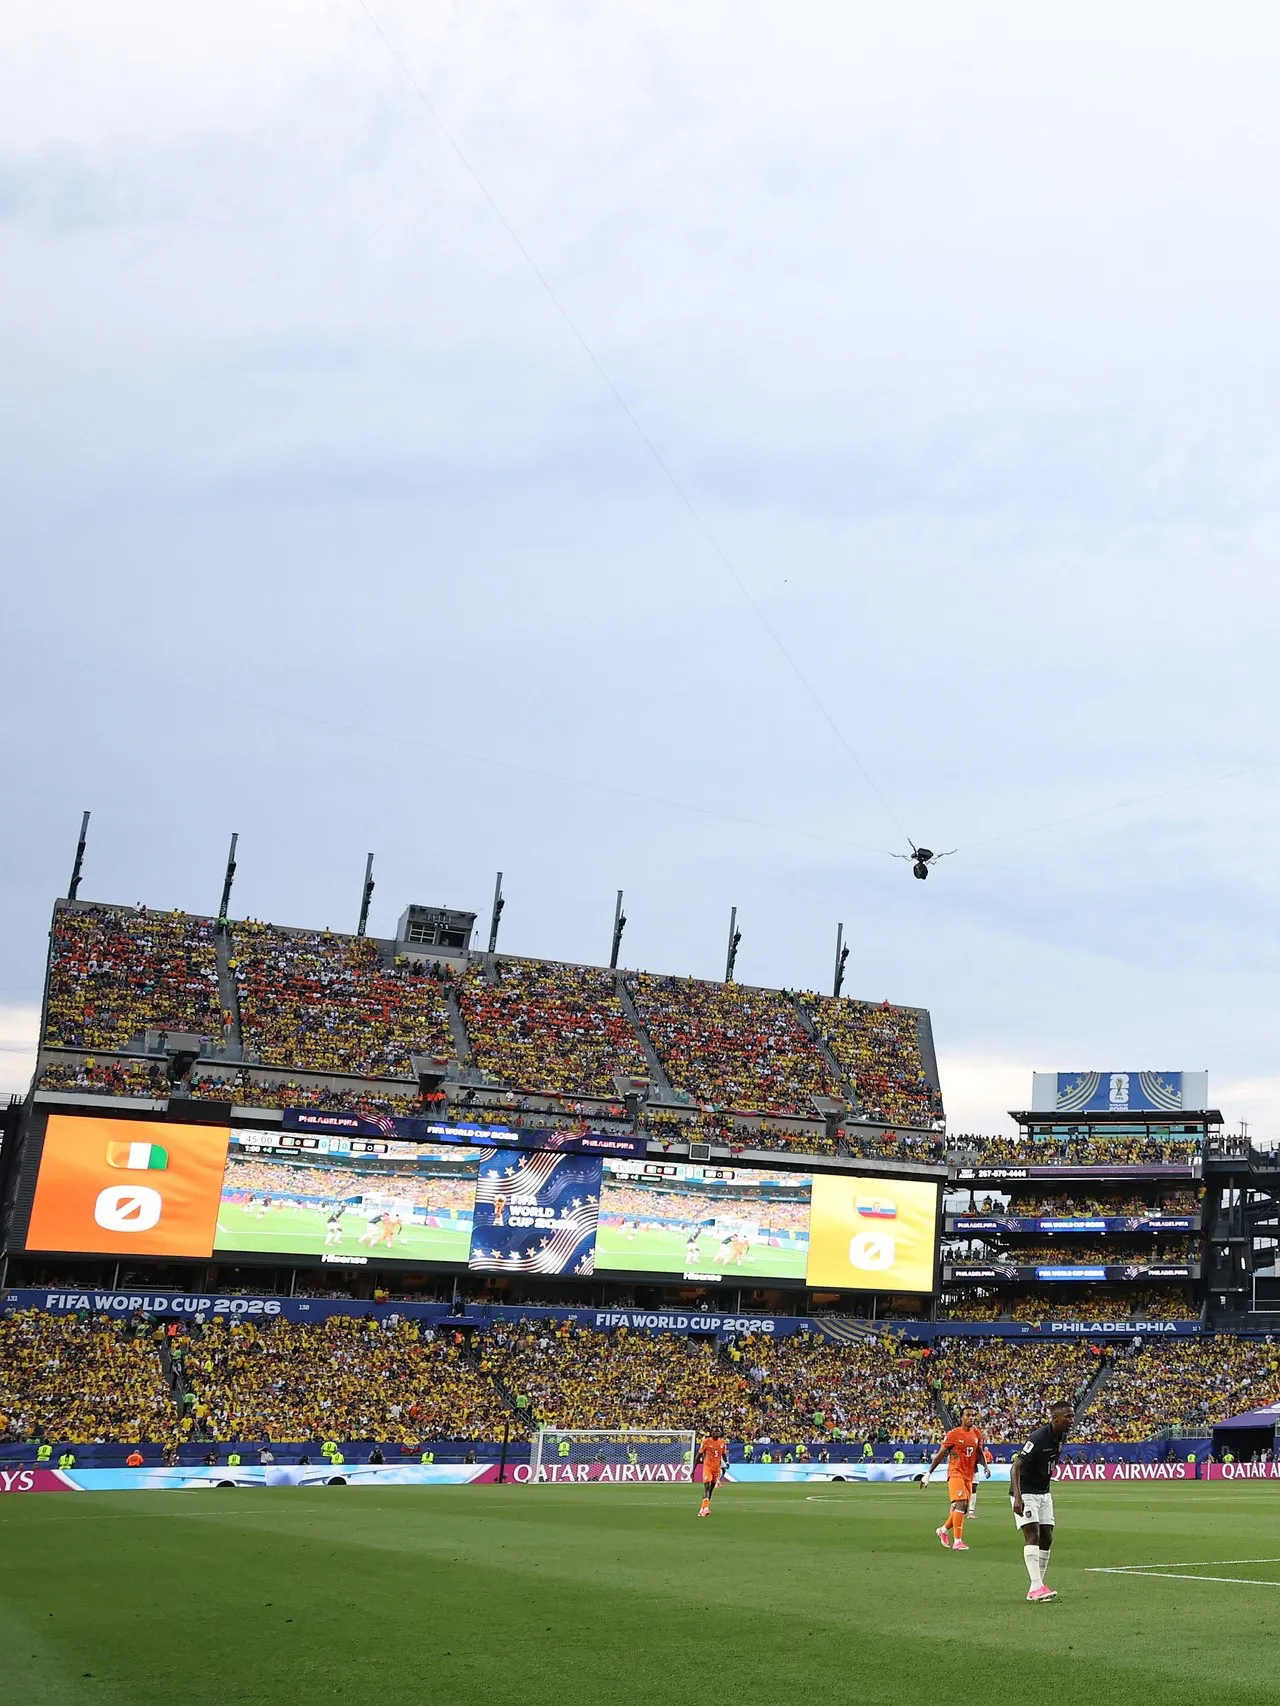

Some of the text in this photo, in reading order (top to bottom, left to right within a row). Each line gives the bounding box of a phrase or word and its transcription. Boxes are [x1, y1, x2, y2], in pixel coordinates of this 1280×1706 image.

[298, 1115, 358, 1126] PHILADELPHIA
[426, 1126, 519, 1140] FIFA WORLD CUP 2026
[581, 1139, 634, 1150] PHILADELPHIA
[510, 1194, 538, 1206] FIFA
[509, 1205, 555, 1218] WORLD
[508, 1216, 534, 1228] CUP
[321, 1254, 368, 1265] Hisense
[45, 1294, 281, 1315] FIFA WORLD CUP 2026
[595, 1313, 775, 1332] FIFA WORLD CUP 2026
[1051, 1322, 1177, 1332] PHILADELPHIA
[714, 1450, 719, 1458] 5
[965, 1446, 974, 1457] 17
[513, 1463, 692, 1484] QATAR AIRWAYS
[1050, 1463, 1186, 1481] QATAR AIRWAYS
[1221, 1463, 1268, 1480] QATAR
[0, 1470, 34, 1491] YS
